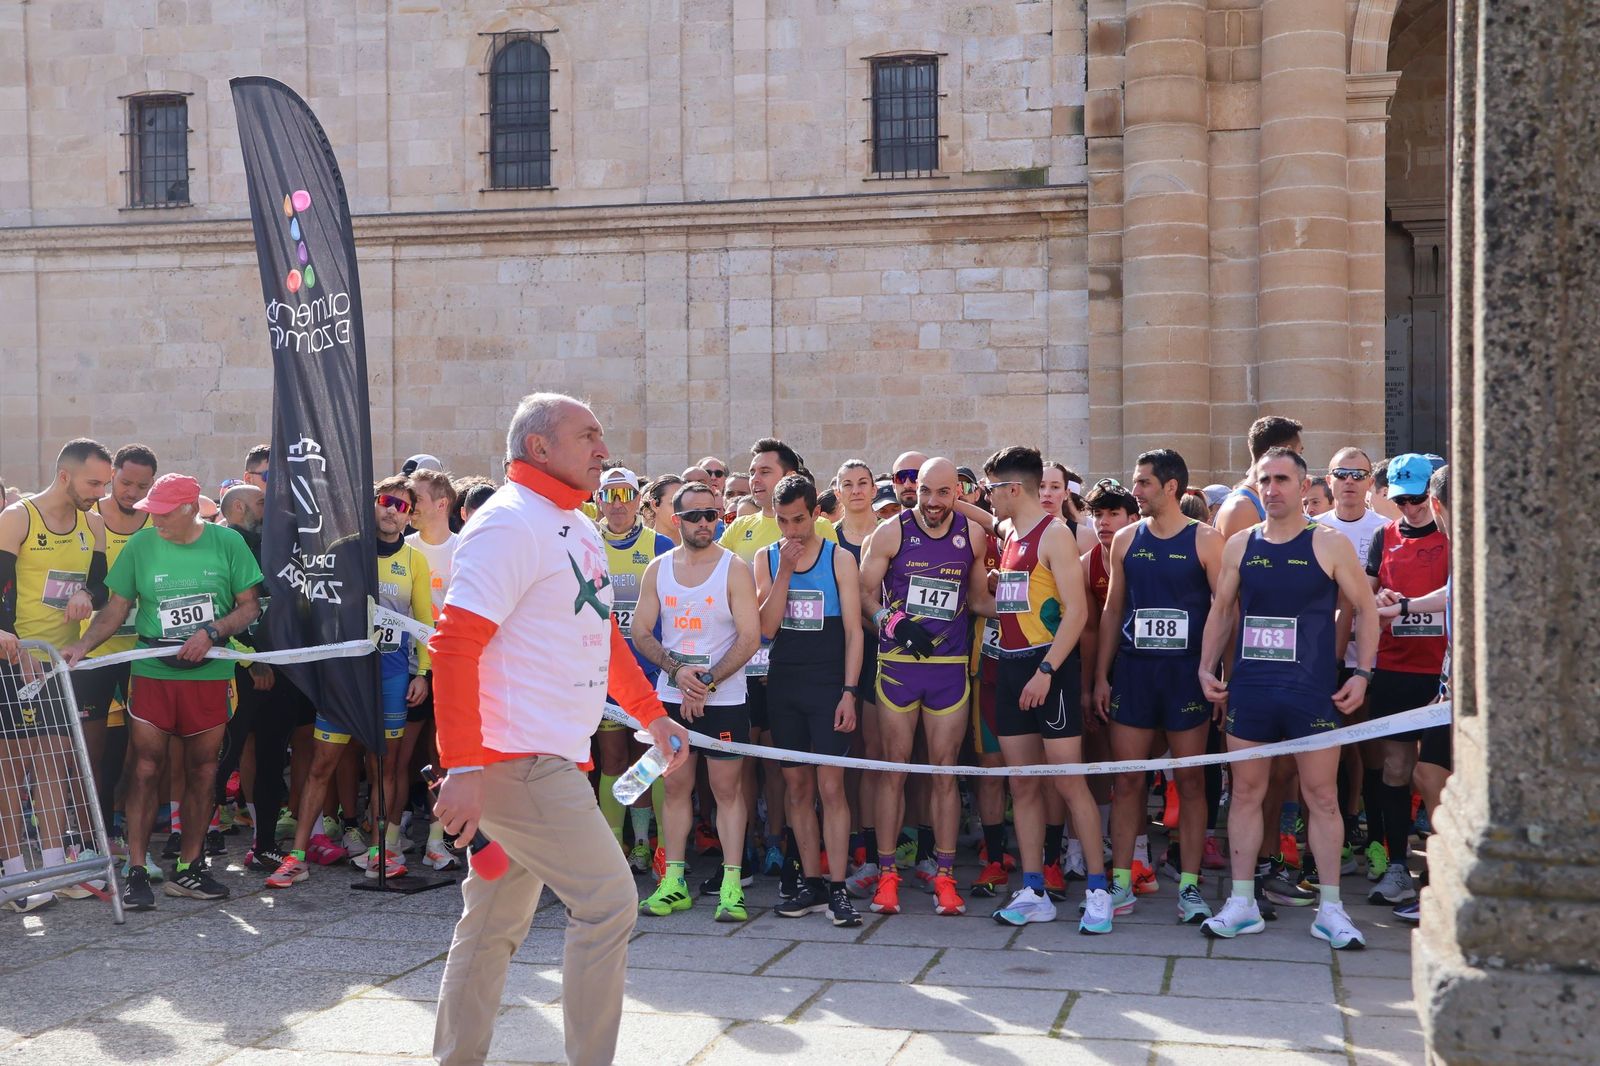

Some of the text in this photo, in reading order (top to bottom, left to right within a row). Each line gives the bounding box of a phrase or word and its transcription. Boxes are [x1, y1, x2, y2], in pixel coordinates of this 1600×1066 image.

[919, 588, 950, 608] 147
[1000, 583, 1020, 601] 707
[170, 605, 204, 626] 350
[1401, 612, 1433, 624] 255
[1145, 619, 1177, 637] 188
[1251, 628, 1285, 648] 763
